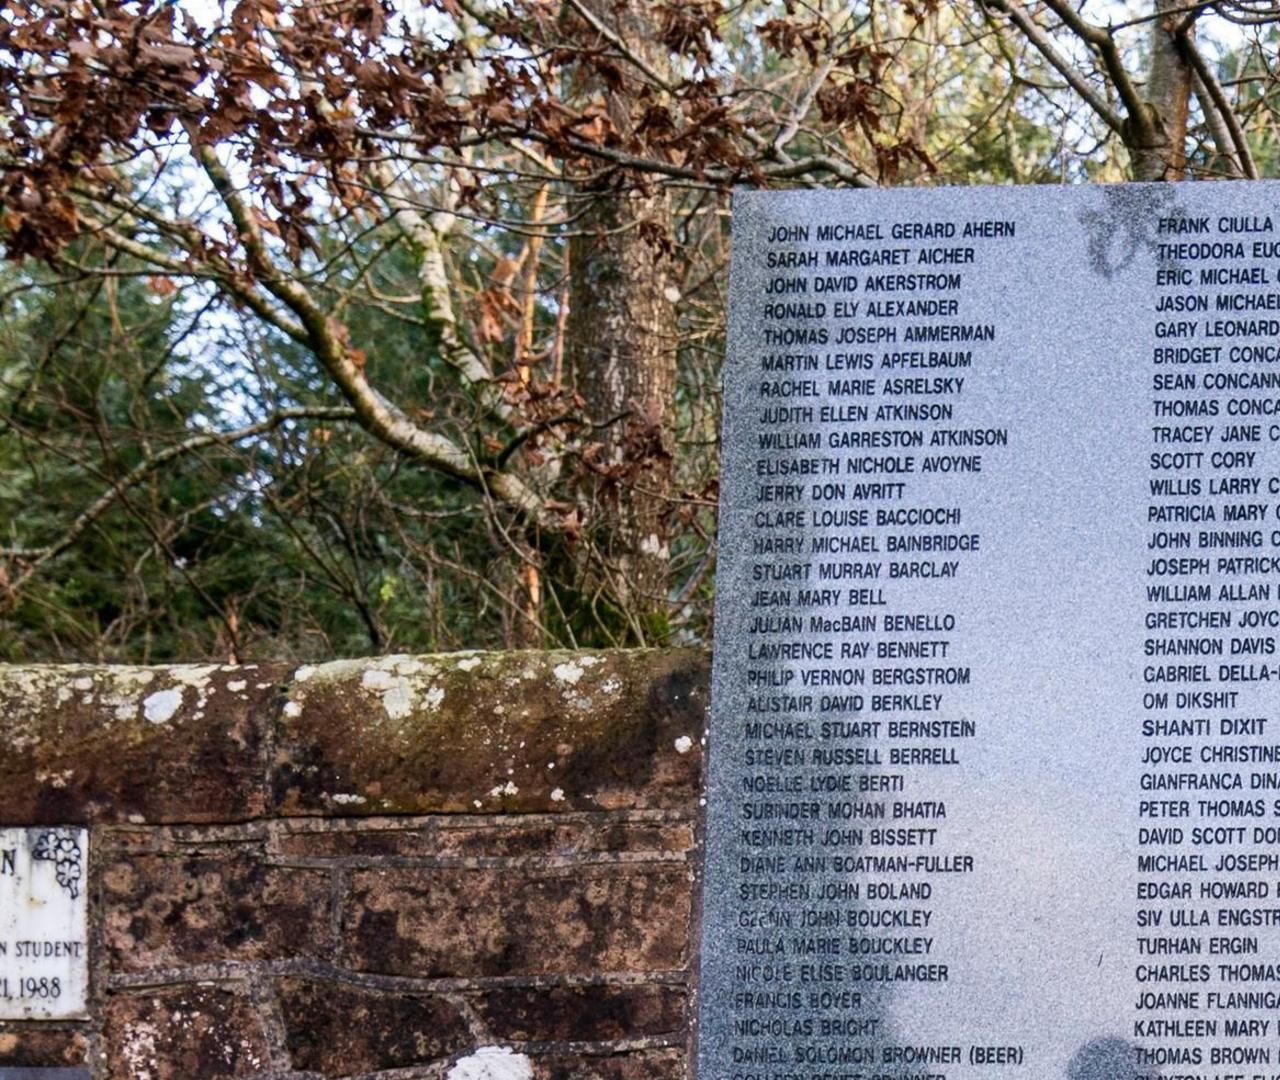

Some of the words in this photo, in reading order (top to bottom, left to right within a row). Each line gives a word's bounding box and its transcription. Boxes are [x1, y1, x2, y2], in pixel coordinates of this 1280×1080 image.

[767, 225, 810, 244] JOHN
[816, 223, 884, 242] MICHAEL
[891, 222, 956, 240] GERARD
[962, 221, 1016, 238] AHERN
[1156, 216, 1210, 235] FRANK
[1217, 216, 1274, 234] CIULLA
[766, 251, 819, 269] SARAH
[825, 248, 911, 267] MARGARET
[917, 247, 975, 265] AICHER
[1157, 242, 1245, 261] THEODORA
[765, 276, 808, 295] JOHN
[813, 275, 859, 293] DAVID
[864, 273, 962, 292] AKERSTROM
[1156, 268, 1193, 286] ERIC
[1200, 267, 1270, 285] MICHAEL
[763, 327, 829, 346] THOMAS
[835, 326, 897, 345] JOSEPH
[903, 325, 995, 342] AMMERMAN
[757, 432, 822, 451] WILLIAM
[828, 430, 924, 448] GARRESTON
[929, 428, 1008, 447] ATKINSON
[753, 510, 806, 529] CLARE
[812, 509, 869, 528] LOUISE
[876, 508, 962, 526] BACCIOCHI
[1147, 505, 1216, 523] PATRICIA
[1223, 503, 1269, 522] MARY
[1141, 718, 1211, 737] SHANTI
[1220, 718, 1268, 736] DIXIT
[1138, 800, 1190, 818] PETER
[1197, 799, 1266, 818] THOMAS
[16, 941, 82, 958] STUDENT
[1135, 964, 1211, 983] CHARLES
[20, 977, 61, 999] 1988
